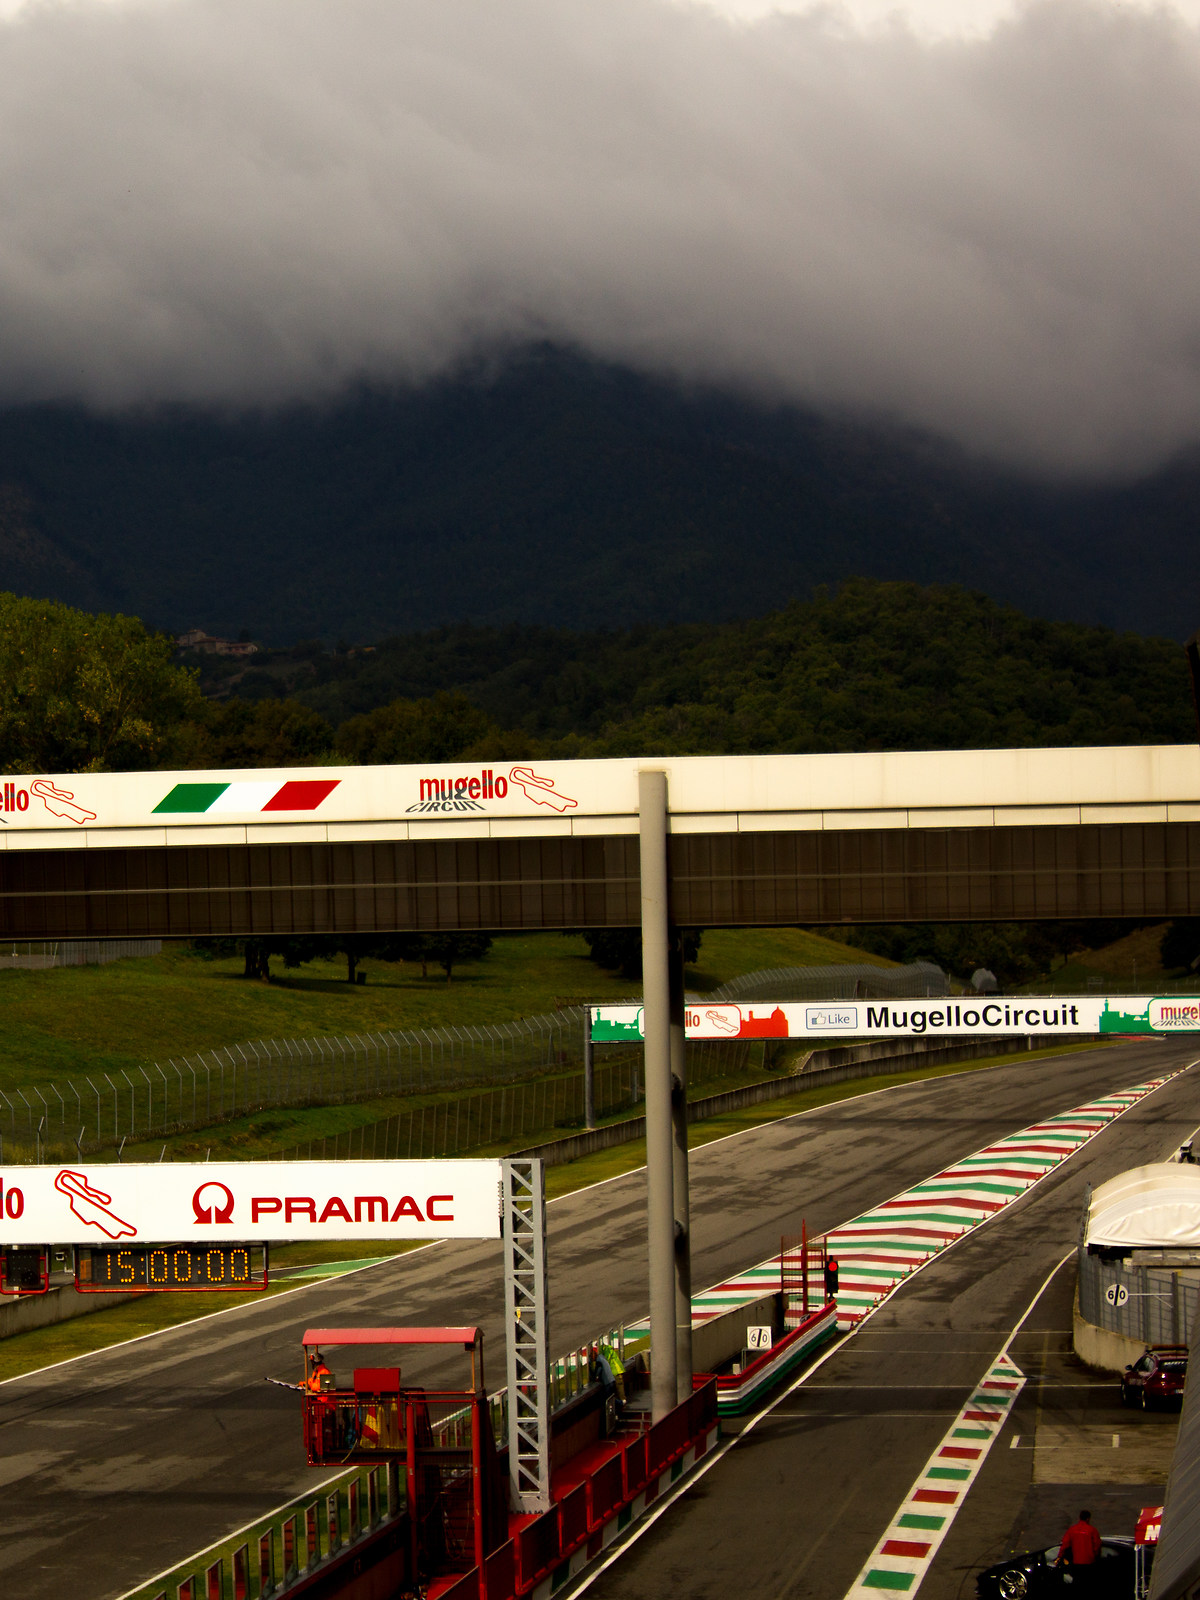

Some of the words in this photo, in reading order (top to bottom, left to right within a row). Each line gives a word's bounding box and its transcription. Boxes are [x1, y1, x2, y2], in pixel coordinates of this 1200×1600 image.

[419, 769, 508, 801] mugello
[404, 800, 487, 813] CIRCUIT
[828, 1013, 851, 1025] Like
[866, 1004, 1080, 1033] MugelloCircuit
[1160, 1002, 1200, 1021] muge
[251, 1194, 455, 1223] PRAMAC
[106, 1250, 249, 1283] 15:00:00
